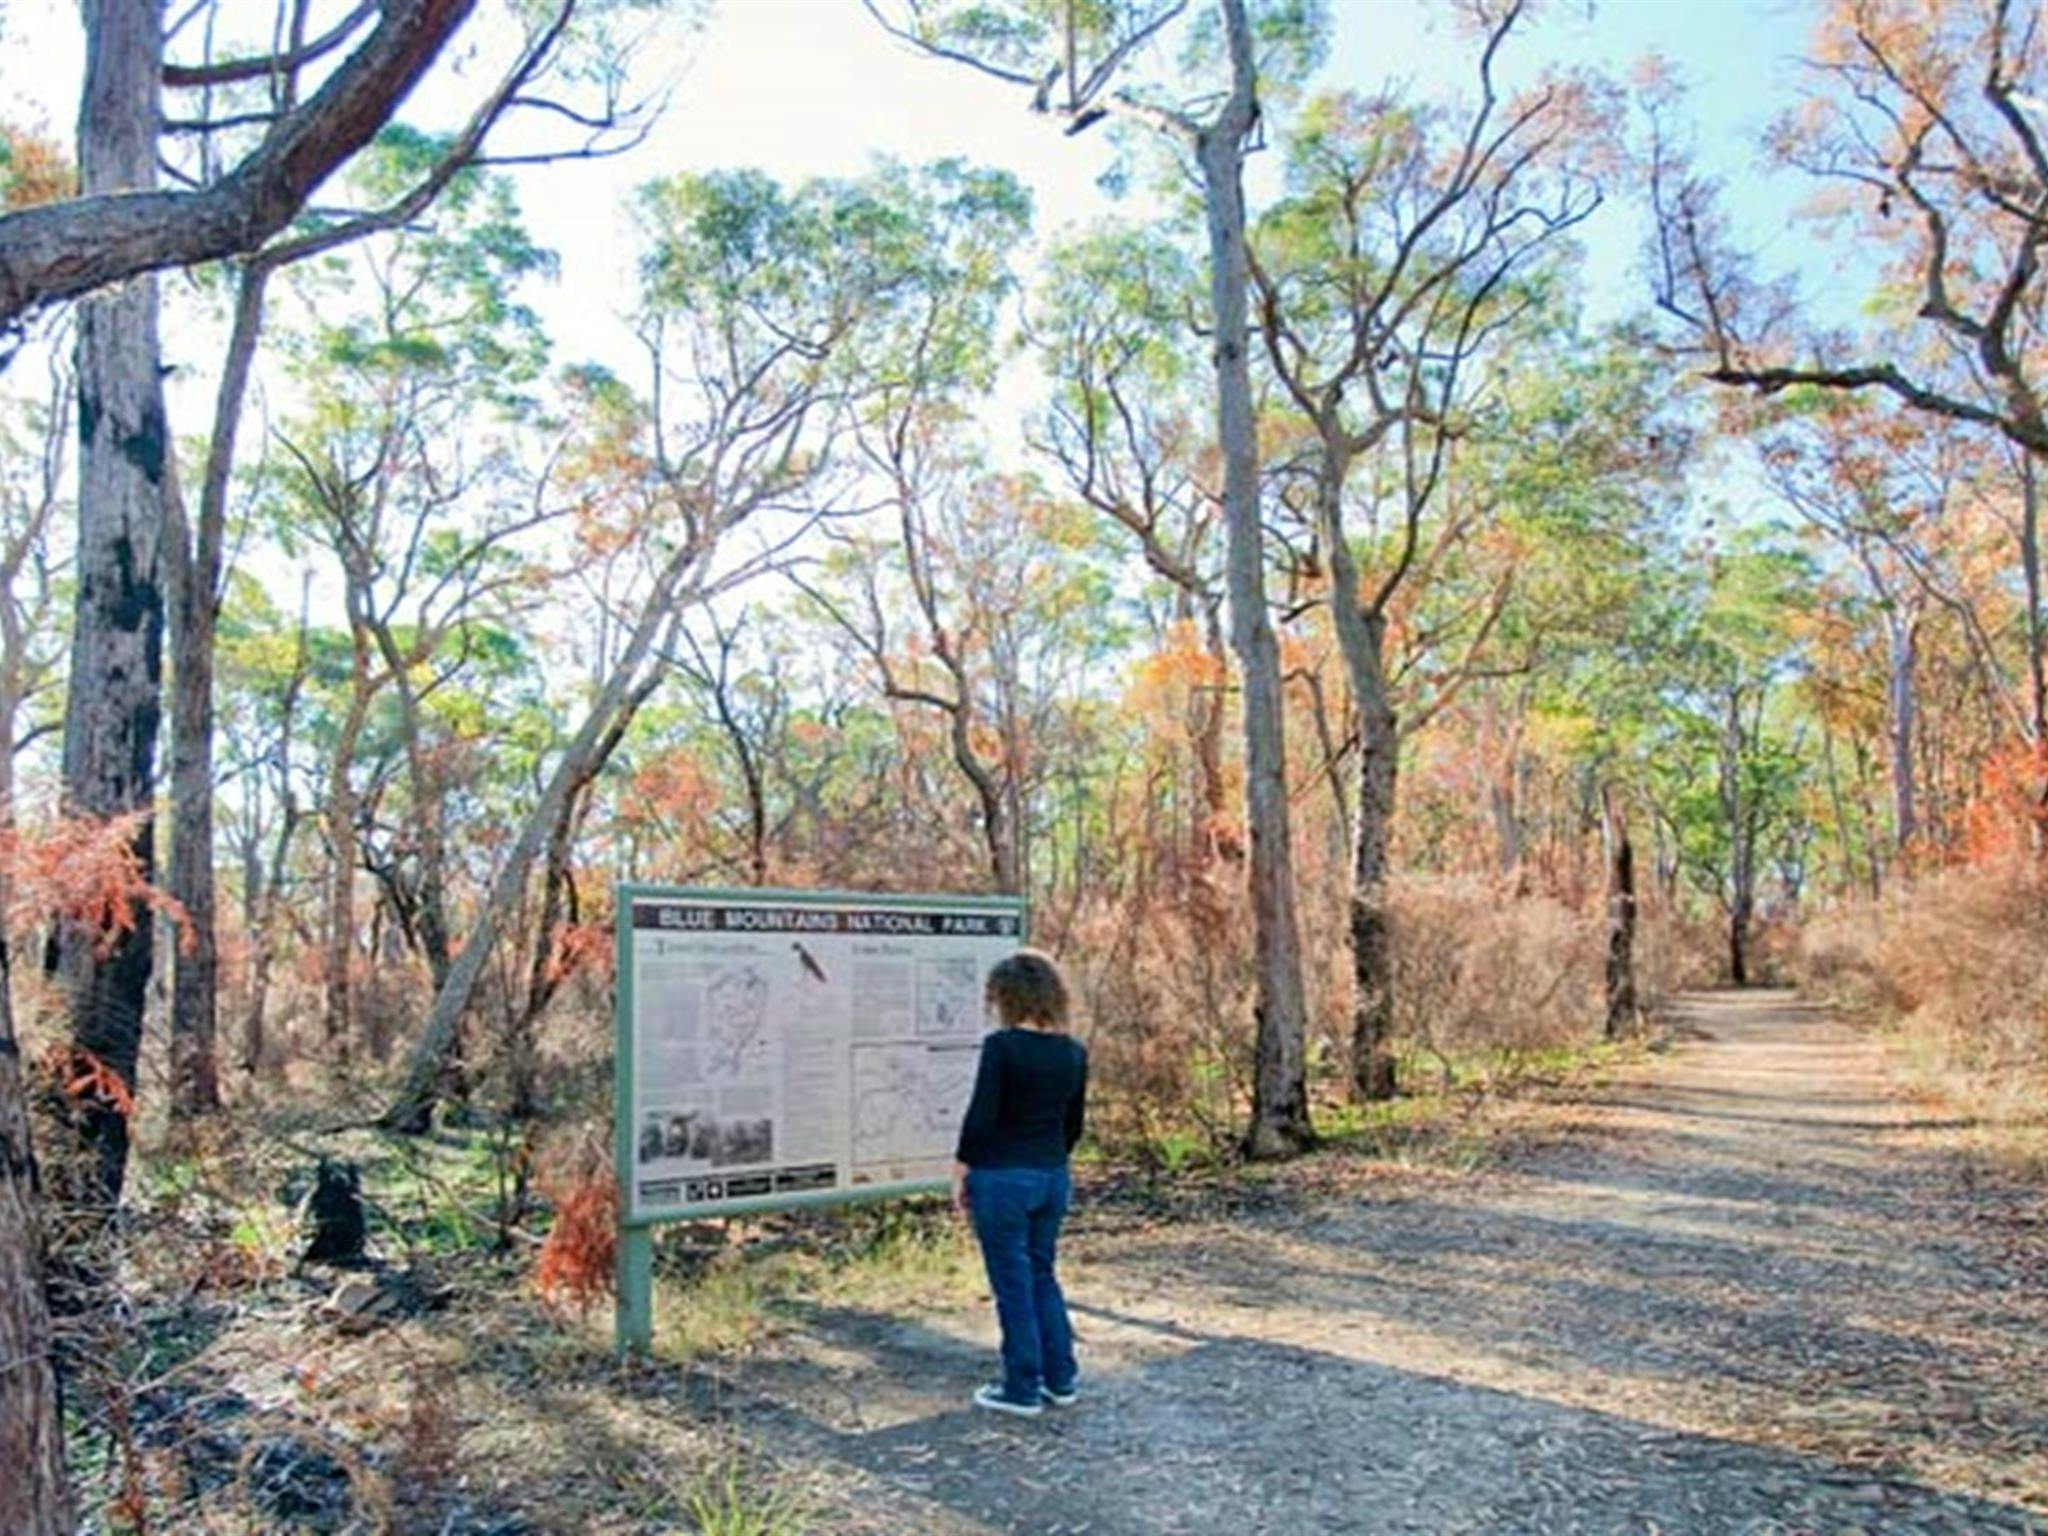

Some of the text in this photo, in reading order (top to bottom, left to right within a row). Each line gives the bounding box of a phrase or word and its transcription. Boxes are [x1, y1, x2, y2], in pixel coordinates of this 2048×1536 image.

[658, 907, 987, 934] BLUE MOUNTAINS NATIONAL PARK
